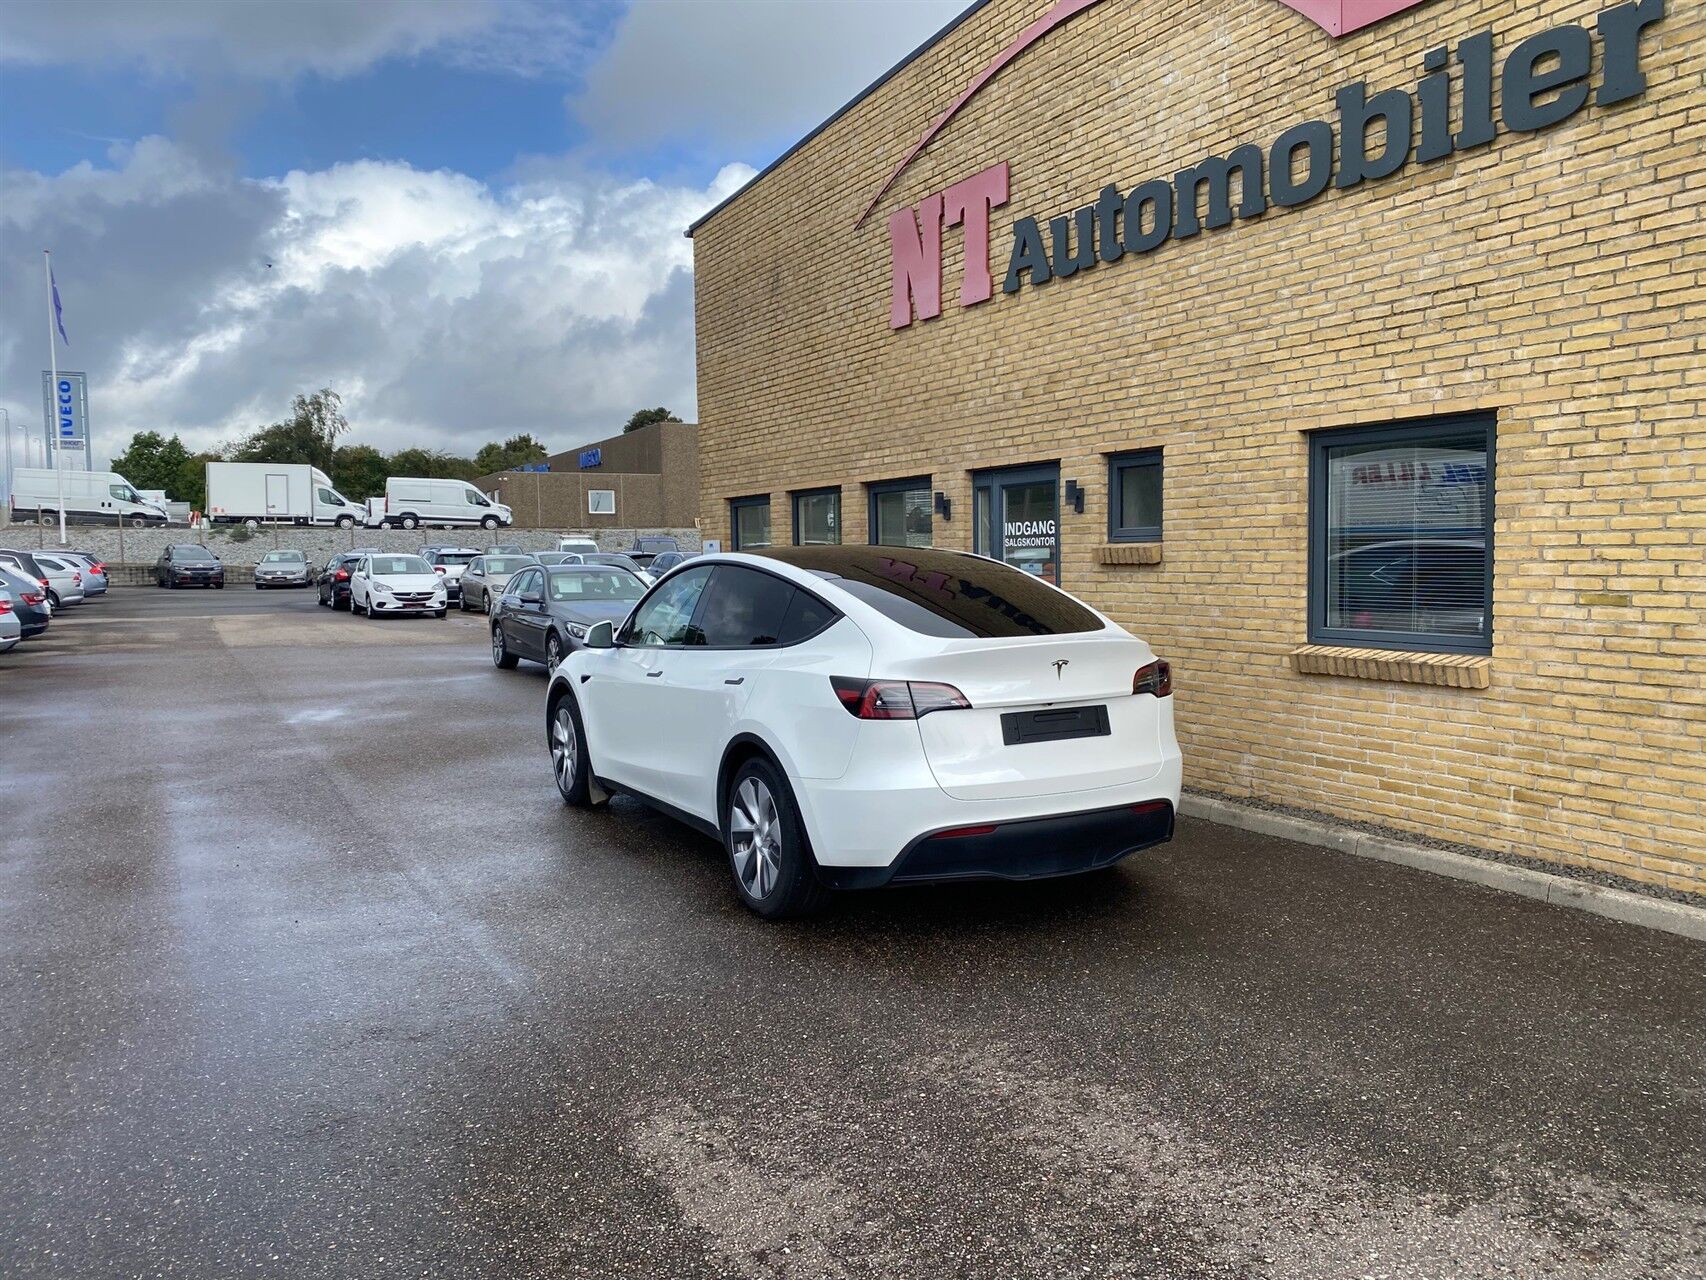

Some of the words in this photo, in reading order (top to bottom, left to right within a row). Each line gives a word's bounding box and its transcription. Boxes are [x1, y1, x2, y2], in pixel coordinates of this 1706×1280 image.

[889, 160, 1010, 329] NT
[1002, 0, 1664, 294] Automobiler
[59, 380, 73, 435] IVECO
[1004, 519, 1056, 536] INDGANG
[1004, 537, 1056, 547] SALGSKONTOR
